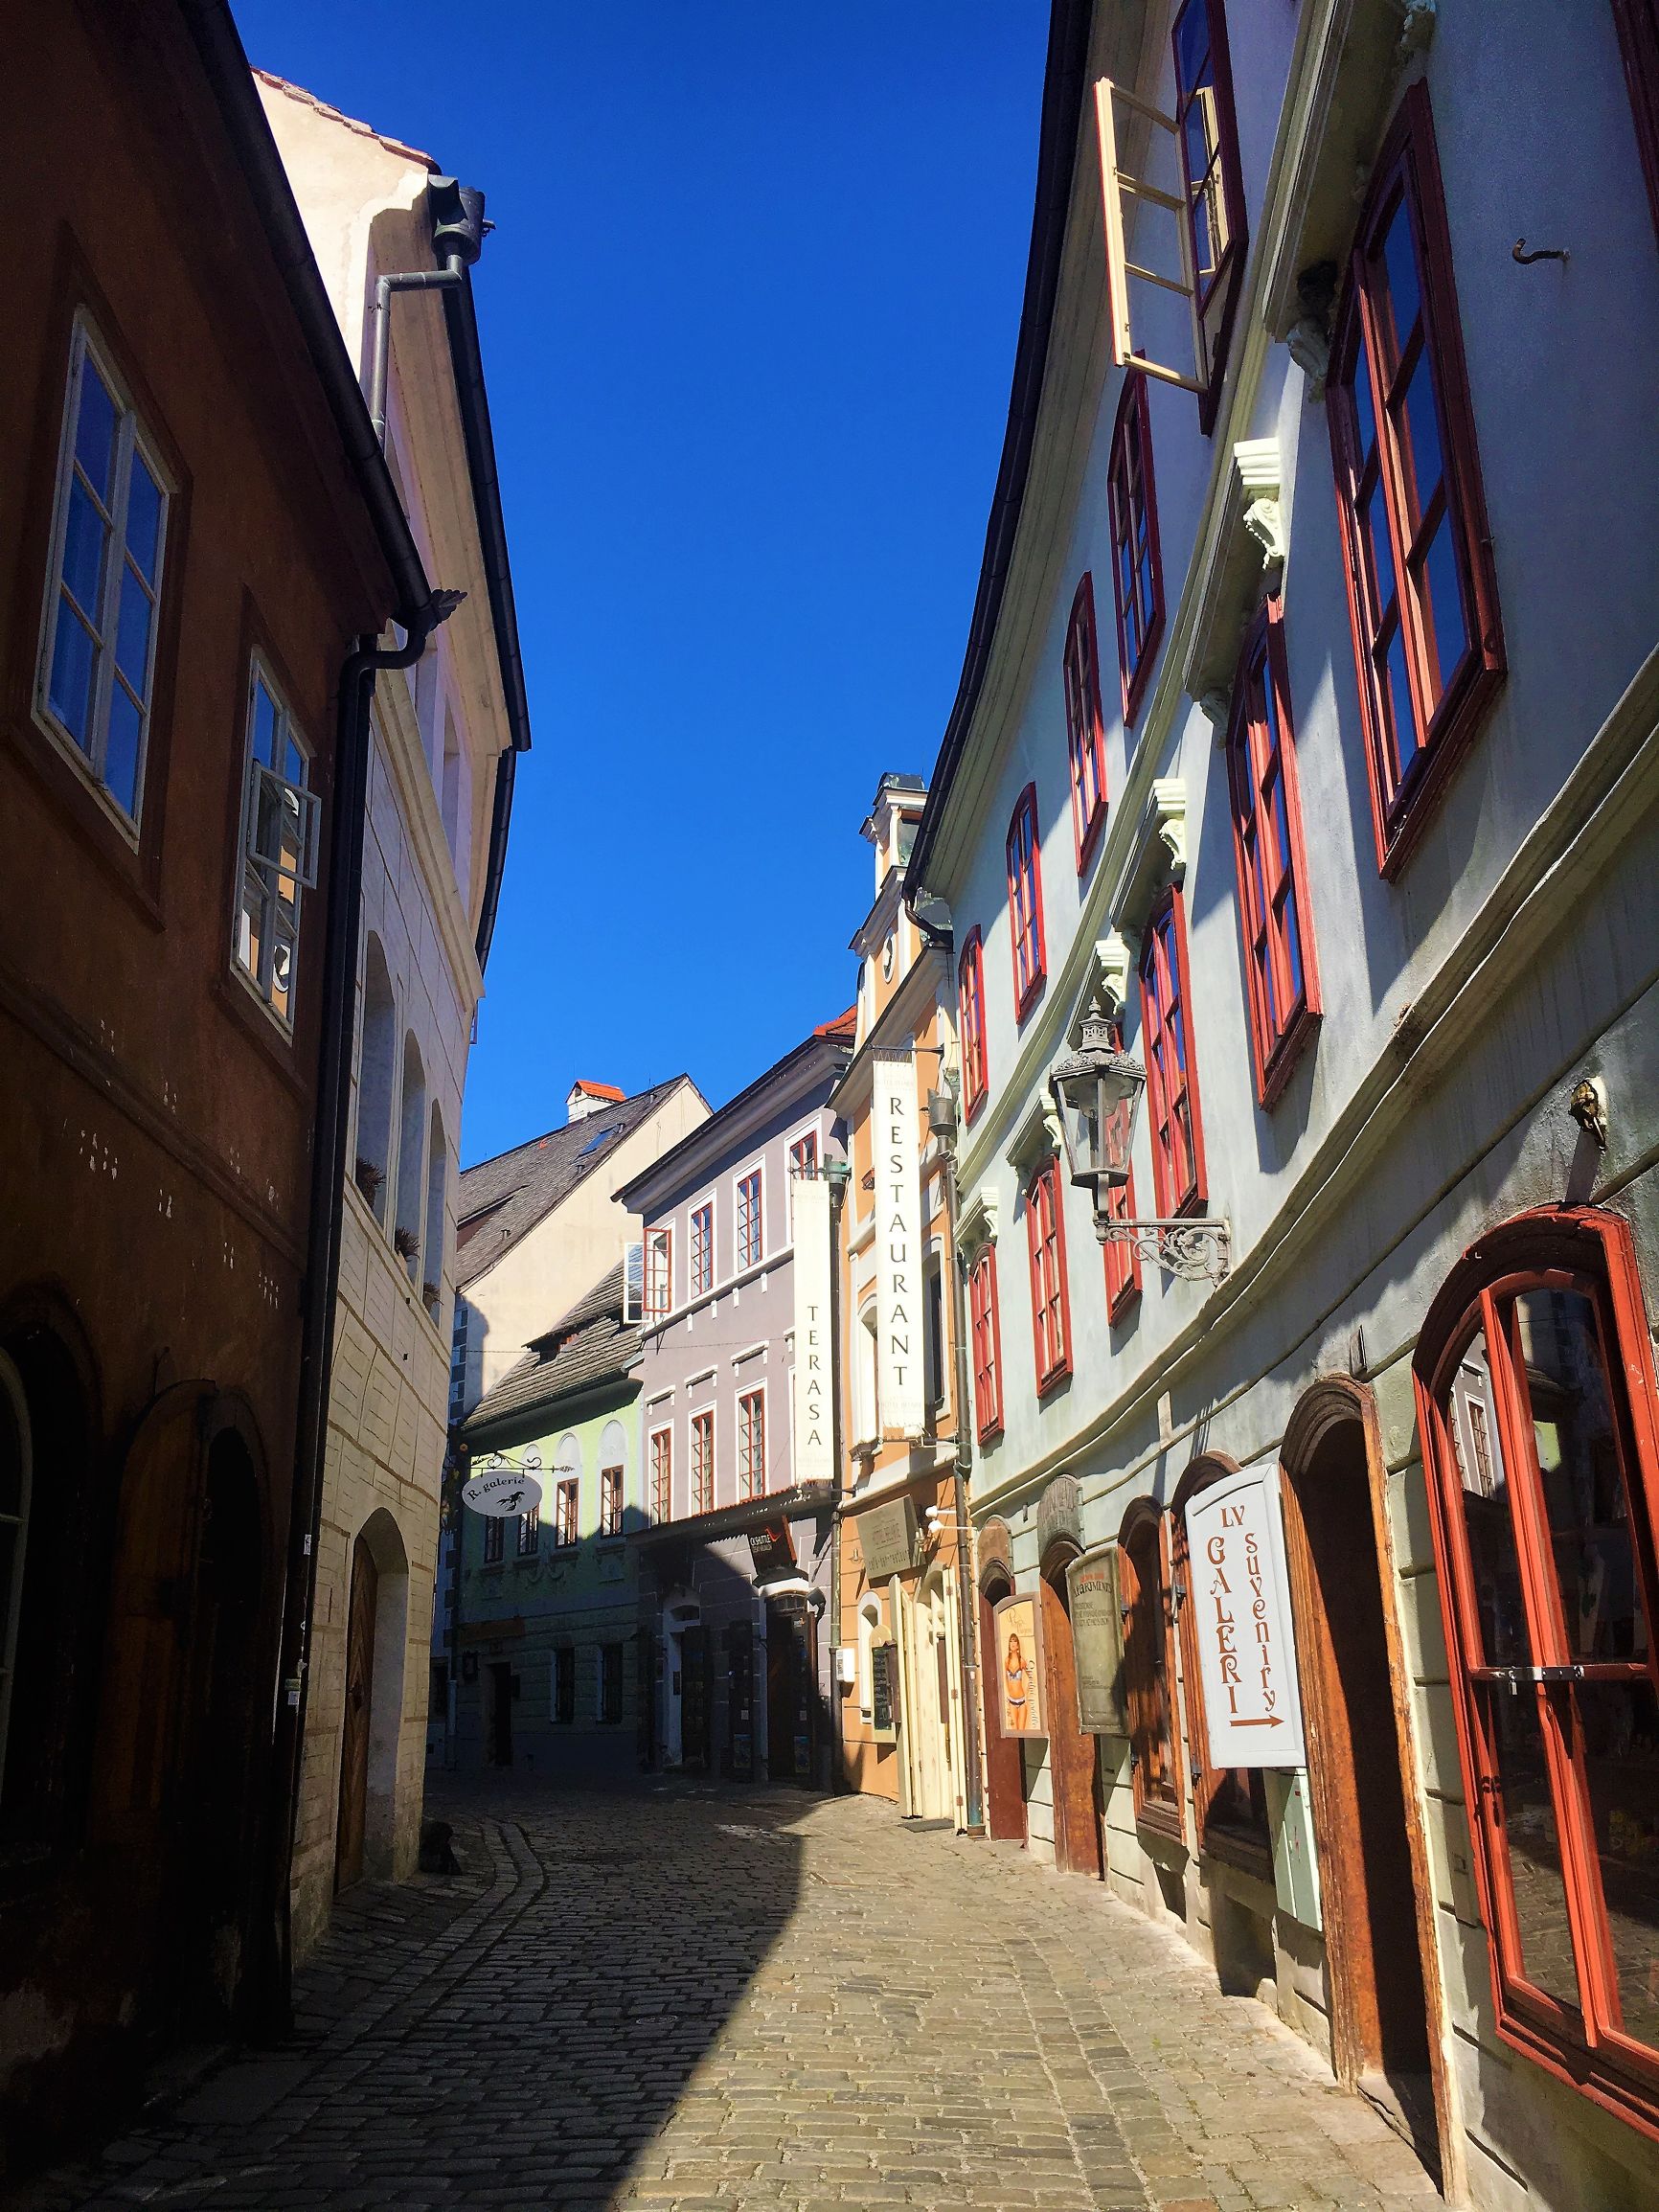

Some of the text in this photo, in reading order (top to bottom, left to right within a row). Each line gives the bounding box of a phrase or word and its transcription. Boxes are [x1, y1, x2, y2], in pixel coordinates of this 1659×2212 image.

[889, 1097, 909, 1386] RESTAURANT
[807, 1306, 822, 1446] TERASA
[466, 1476, 525, 1501] R. galerie
[1220, 1505, 1245, 1528] LV
[1207, 1536, 1242, 1714] GALERI
